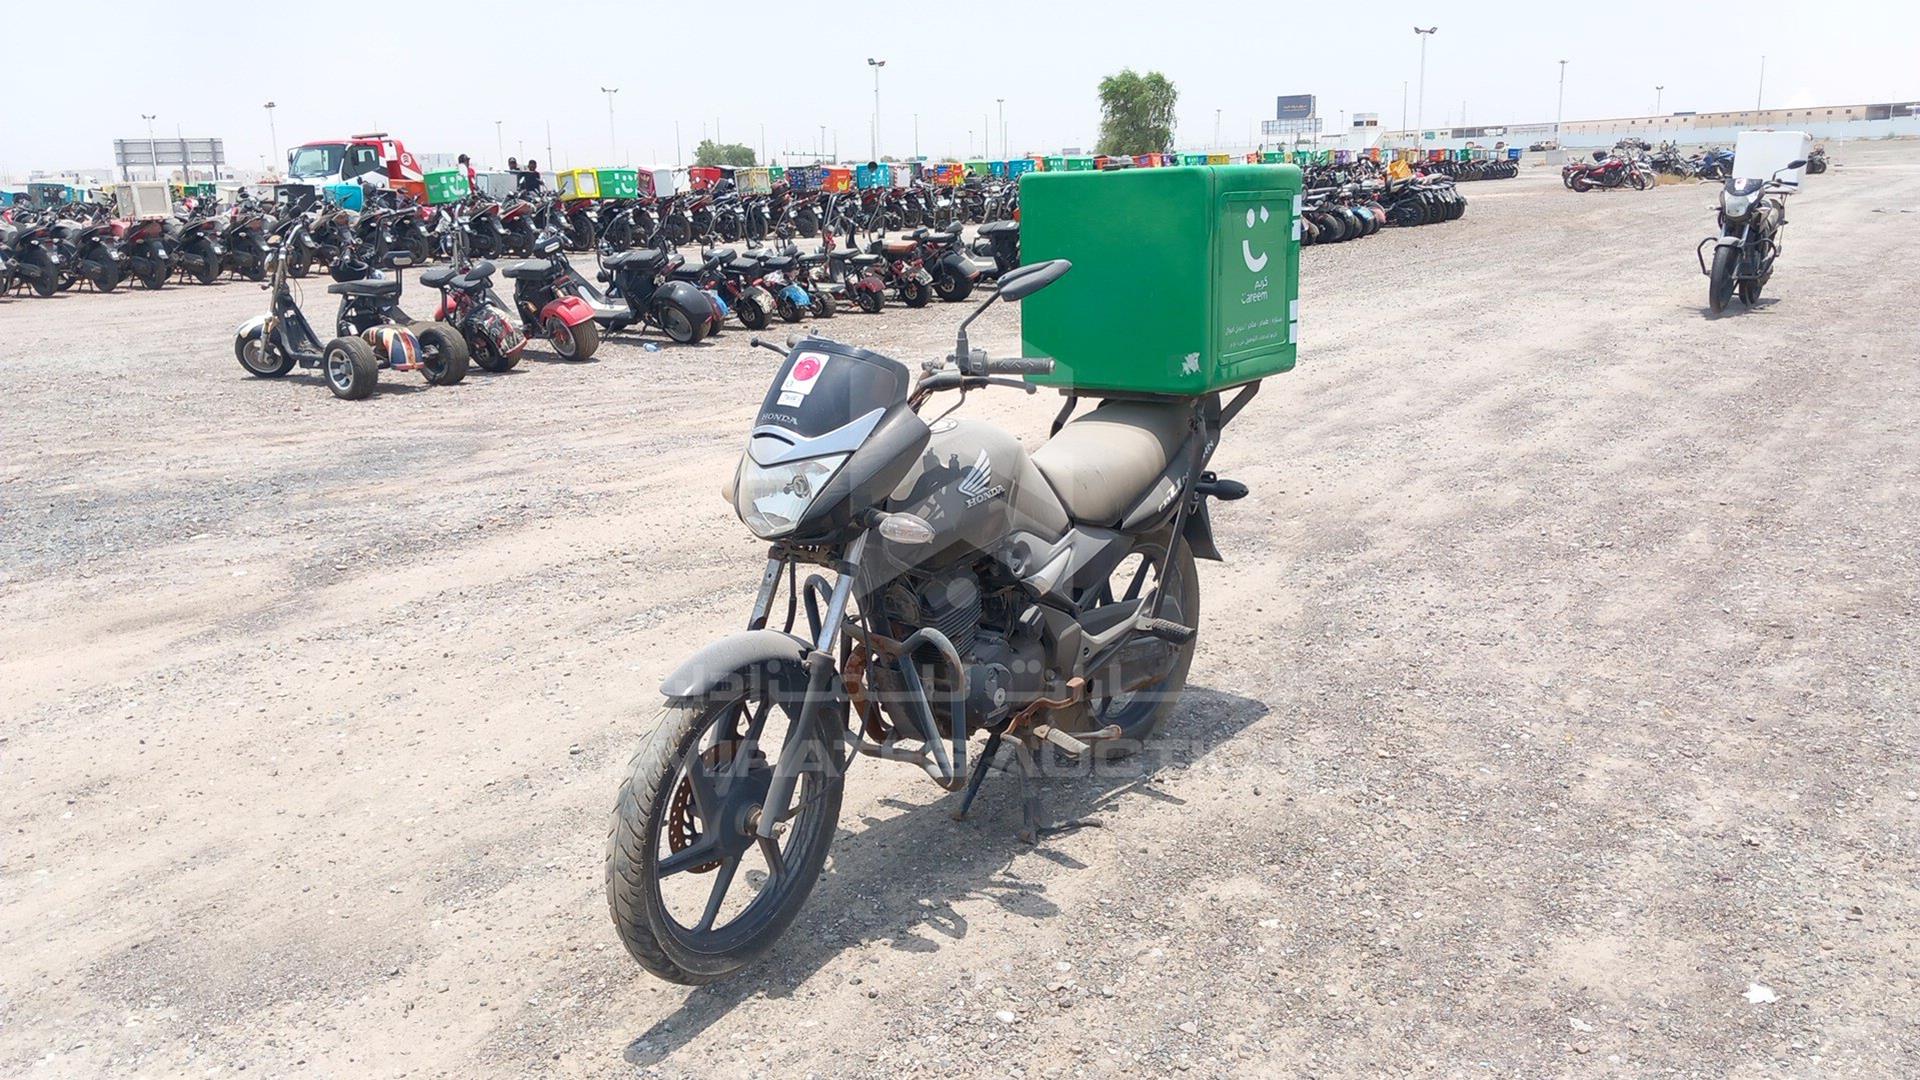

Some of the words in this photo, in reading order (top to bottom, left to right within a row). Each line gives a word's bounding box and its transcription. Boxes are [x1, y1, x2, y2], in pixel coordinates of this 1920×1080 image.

[1240, 287, 1268, 305] Careem
[761, 413, 799, 425] HONDA
[965, 484, 1006, 508] HONDA
